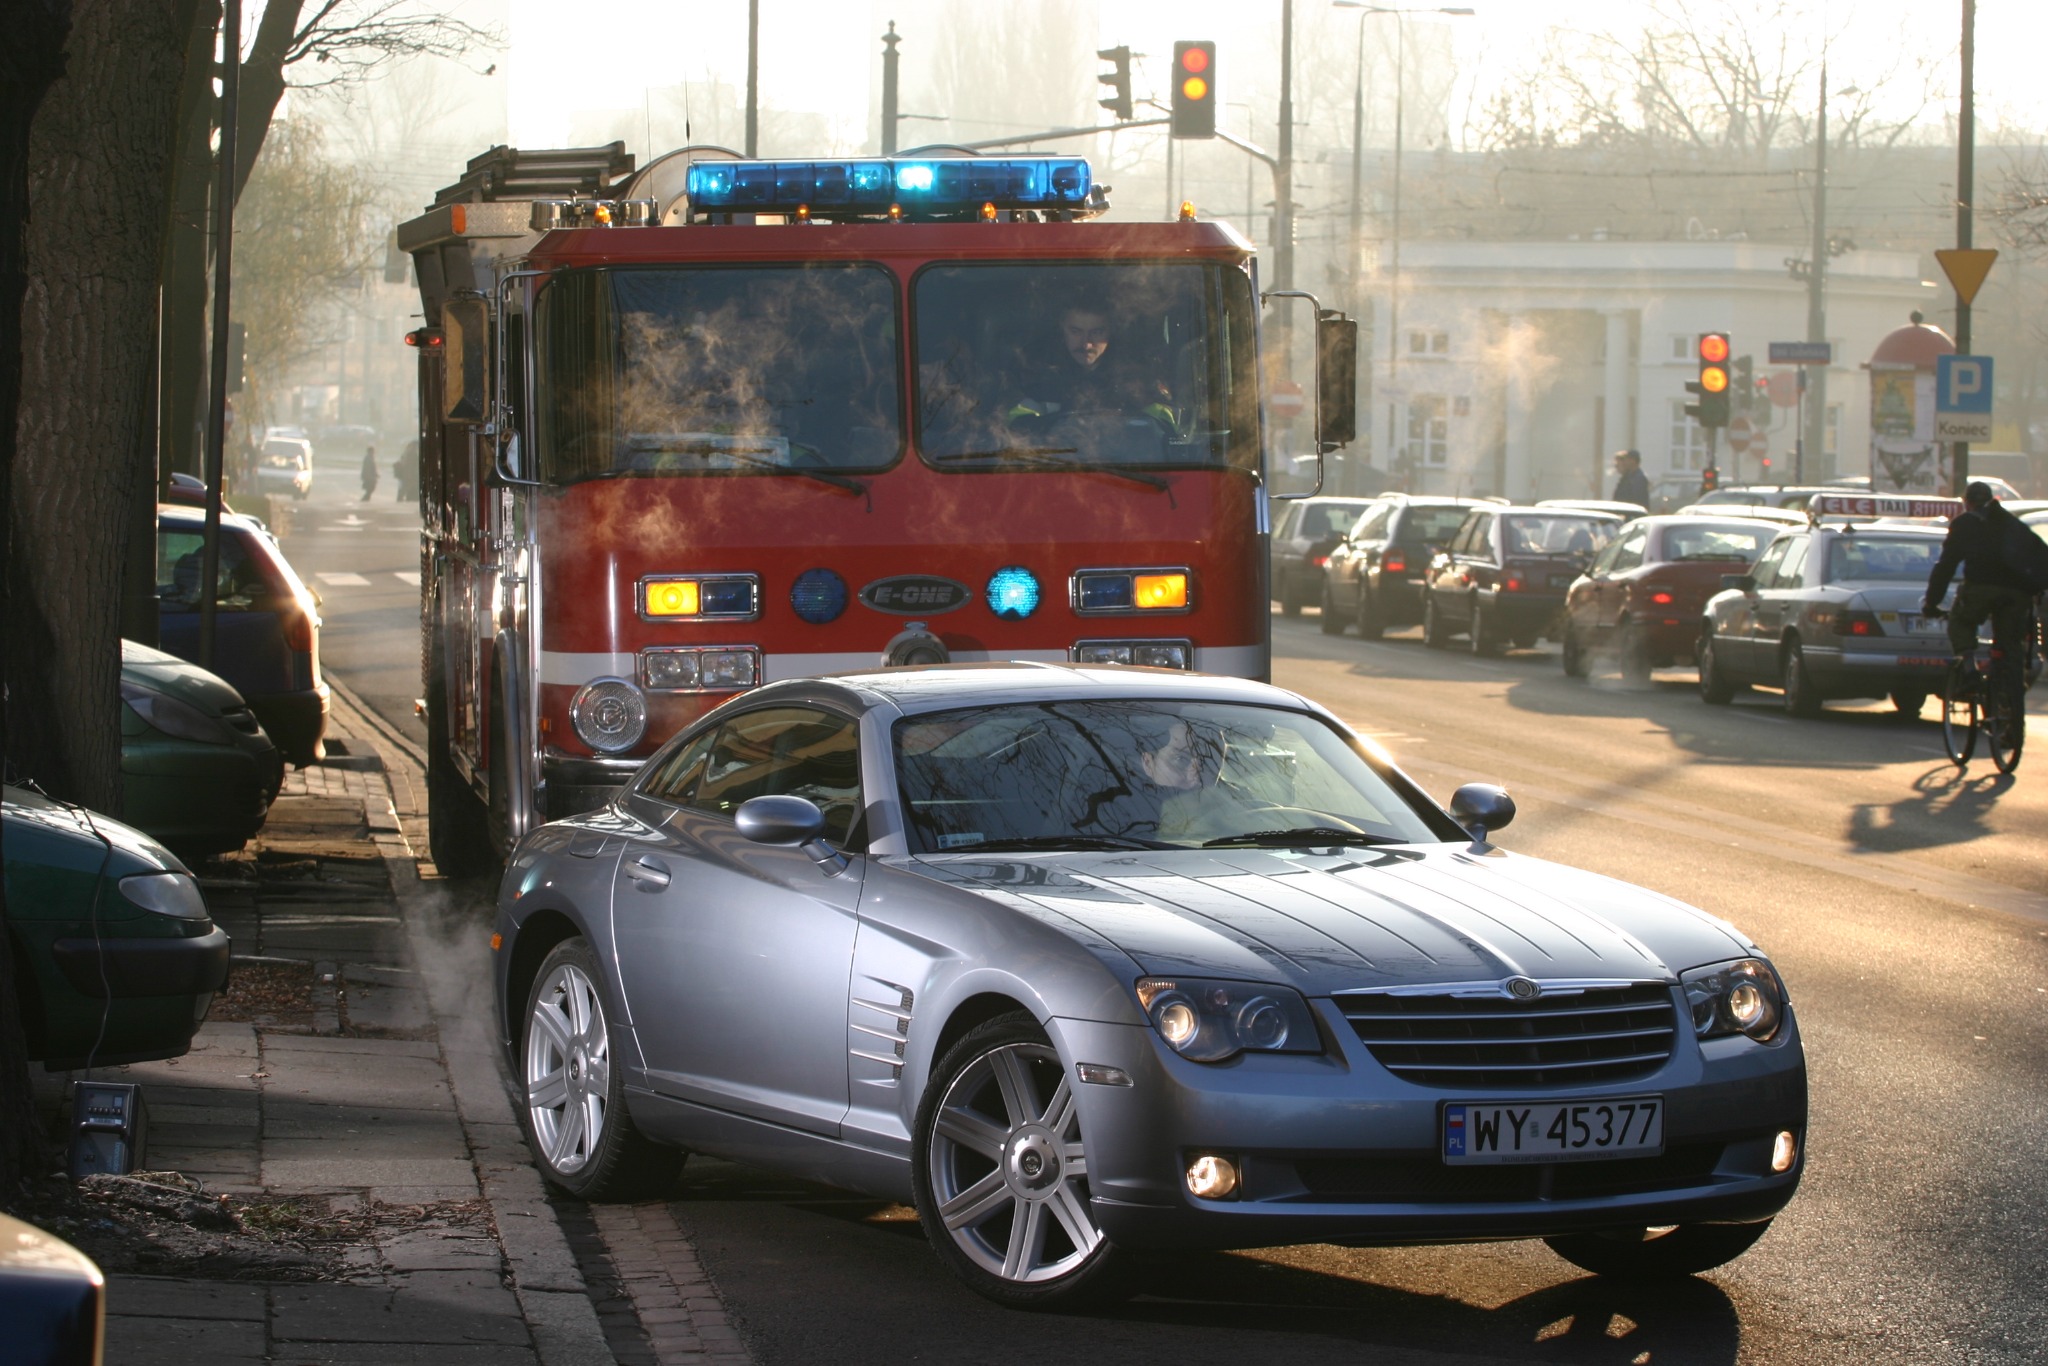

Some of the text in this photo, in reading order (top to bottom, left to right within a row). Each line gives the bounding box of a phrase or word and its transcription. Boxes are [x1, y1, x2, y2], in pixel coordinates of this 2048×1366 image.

[1950, 362, 1982, 406] P
[1939, 421, 1988, 436] Koniec
[1825, 498, 1872, 514] ELE
[1879, 500, 1907, 513] TAXI
[874, 586, 954, 604] E-ONE
[1898, 656, 1948, 666] HOTEL
[1474, 1103, 1657, 1151] WY 45377
[1449, 1138, 1463, 1149] PL
